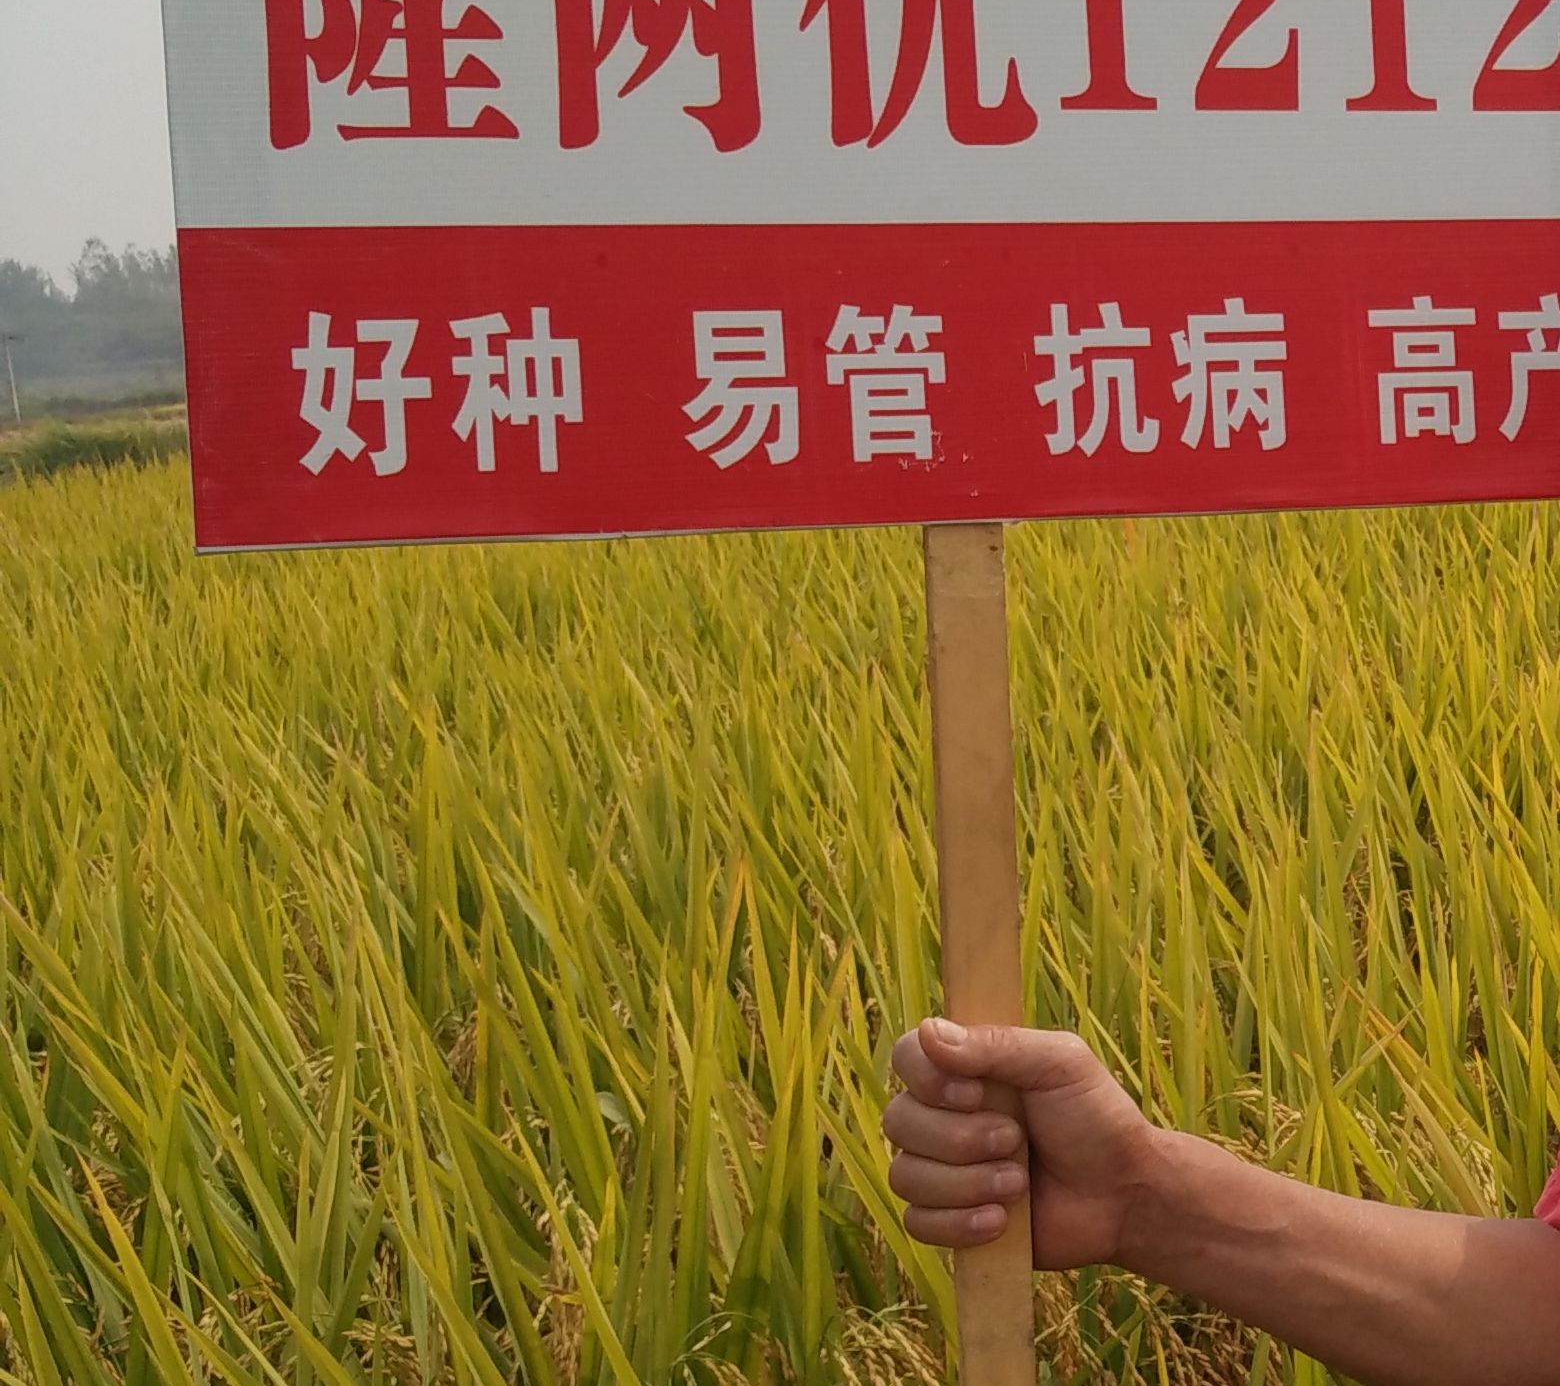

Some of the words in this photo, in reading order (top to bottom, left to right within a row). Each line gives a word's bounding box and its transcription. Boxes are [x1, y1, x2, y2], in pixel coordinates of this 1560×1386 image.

[289, 306, 585, 477] 好种
[682, 302, 948, 471] 易管
[1033, 294, 1289, 458] 抗病
